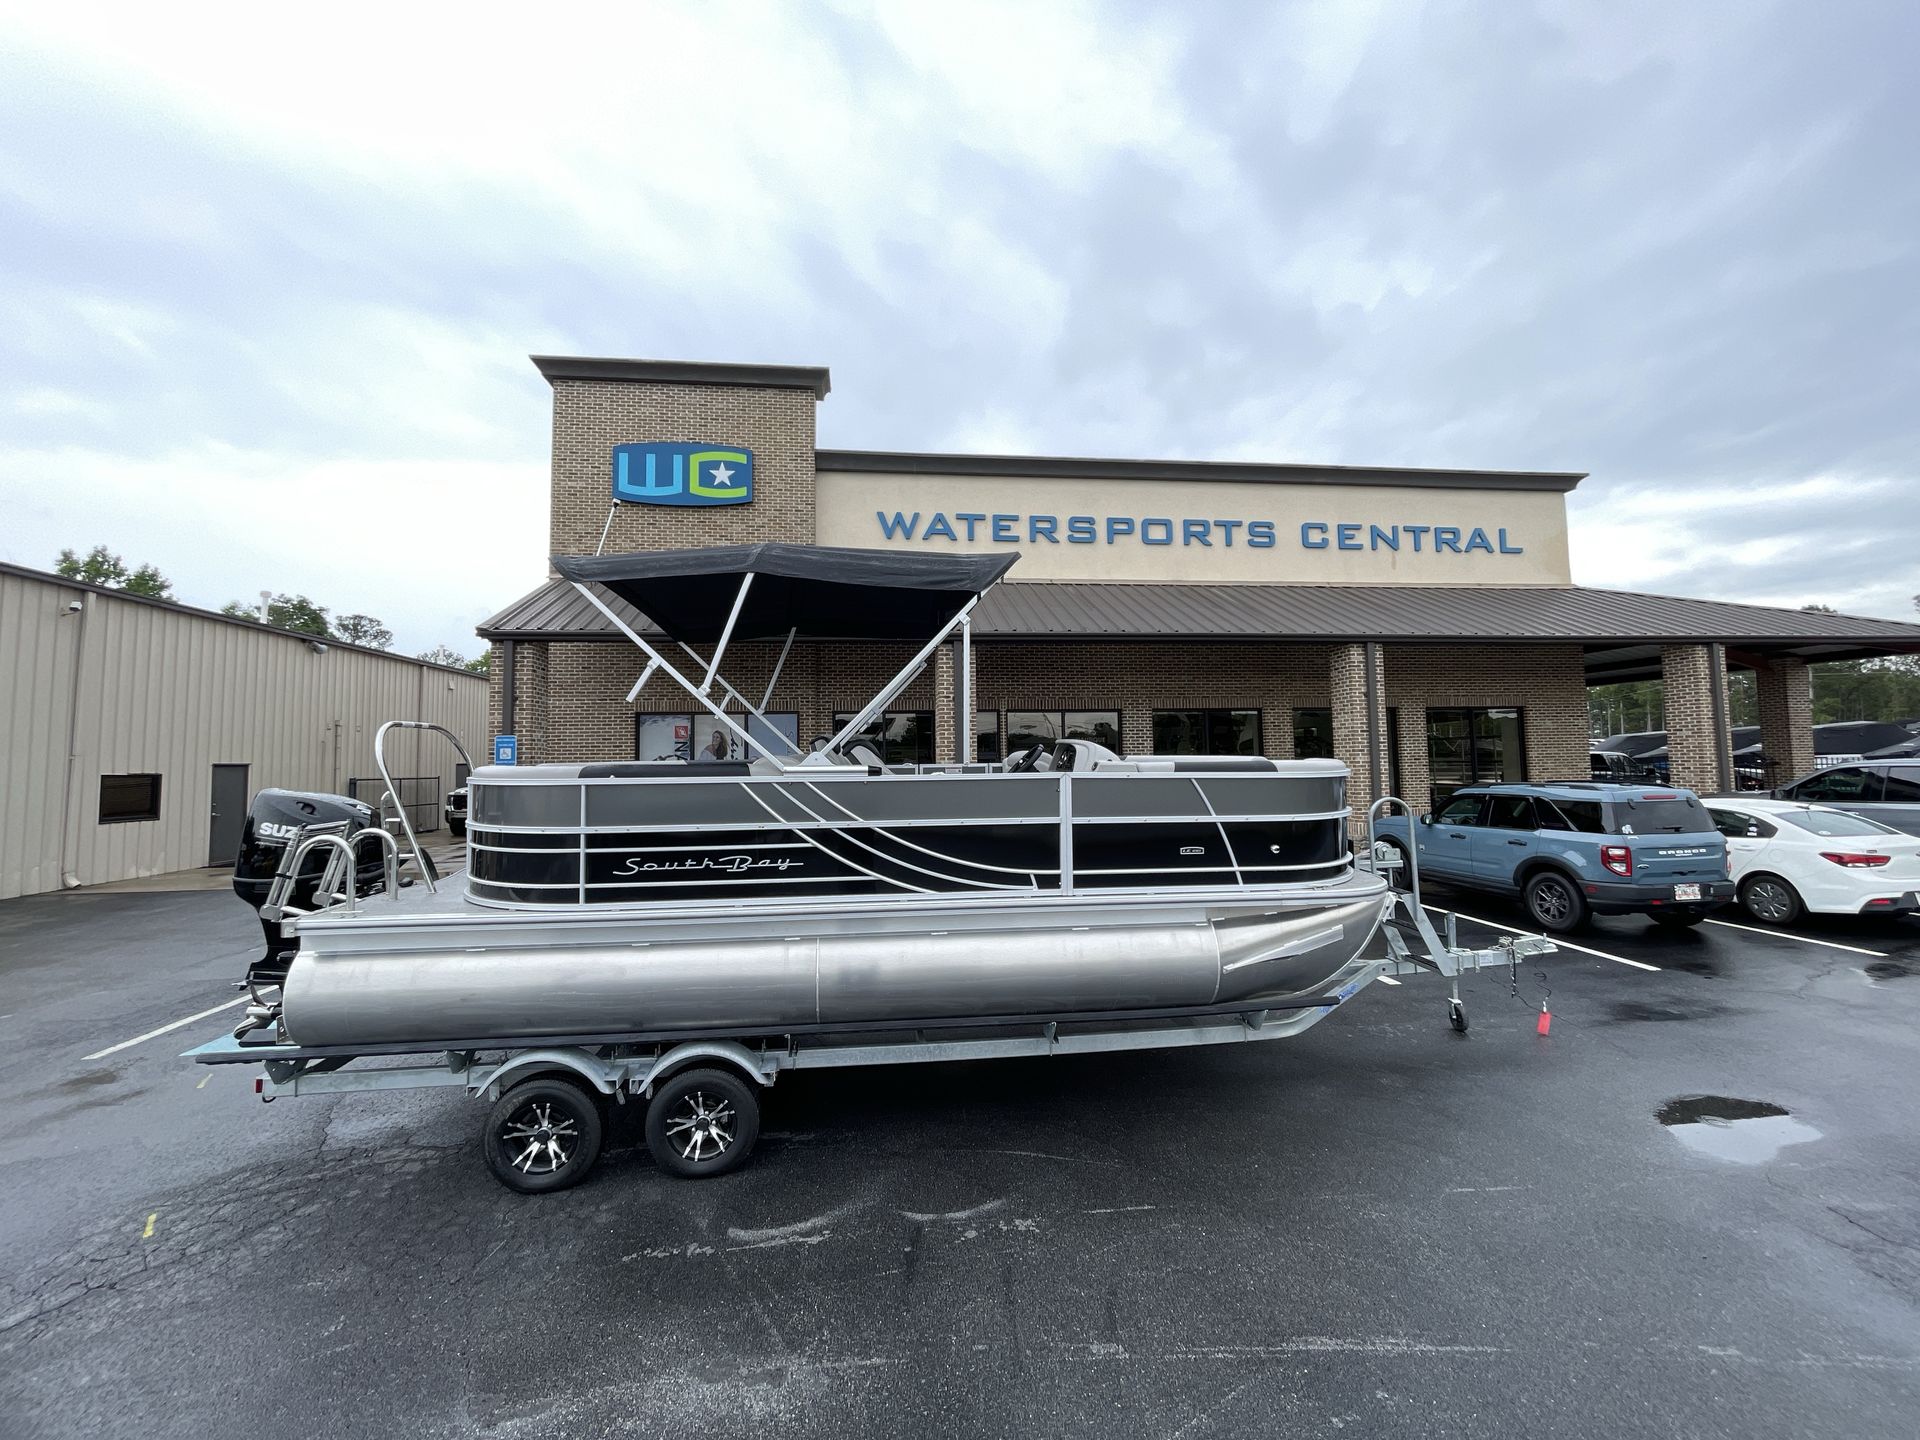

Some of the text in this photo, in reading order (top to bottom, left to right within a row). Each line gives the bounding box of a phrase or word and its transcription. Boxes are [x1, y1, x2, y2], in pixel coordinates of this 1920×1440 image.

[618, 451, 747, 498] WC
[876, 511, 1524, 554] WATERSPORTS CENTRAL
[613, 855, 805, 876] South Bay
